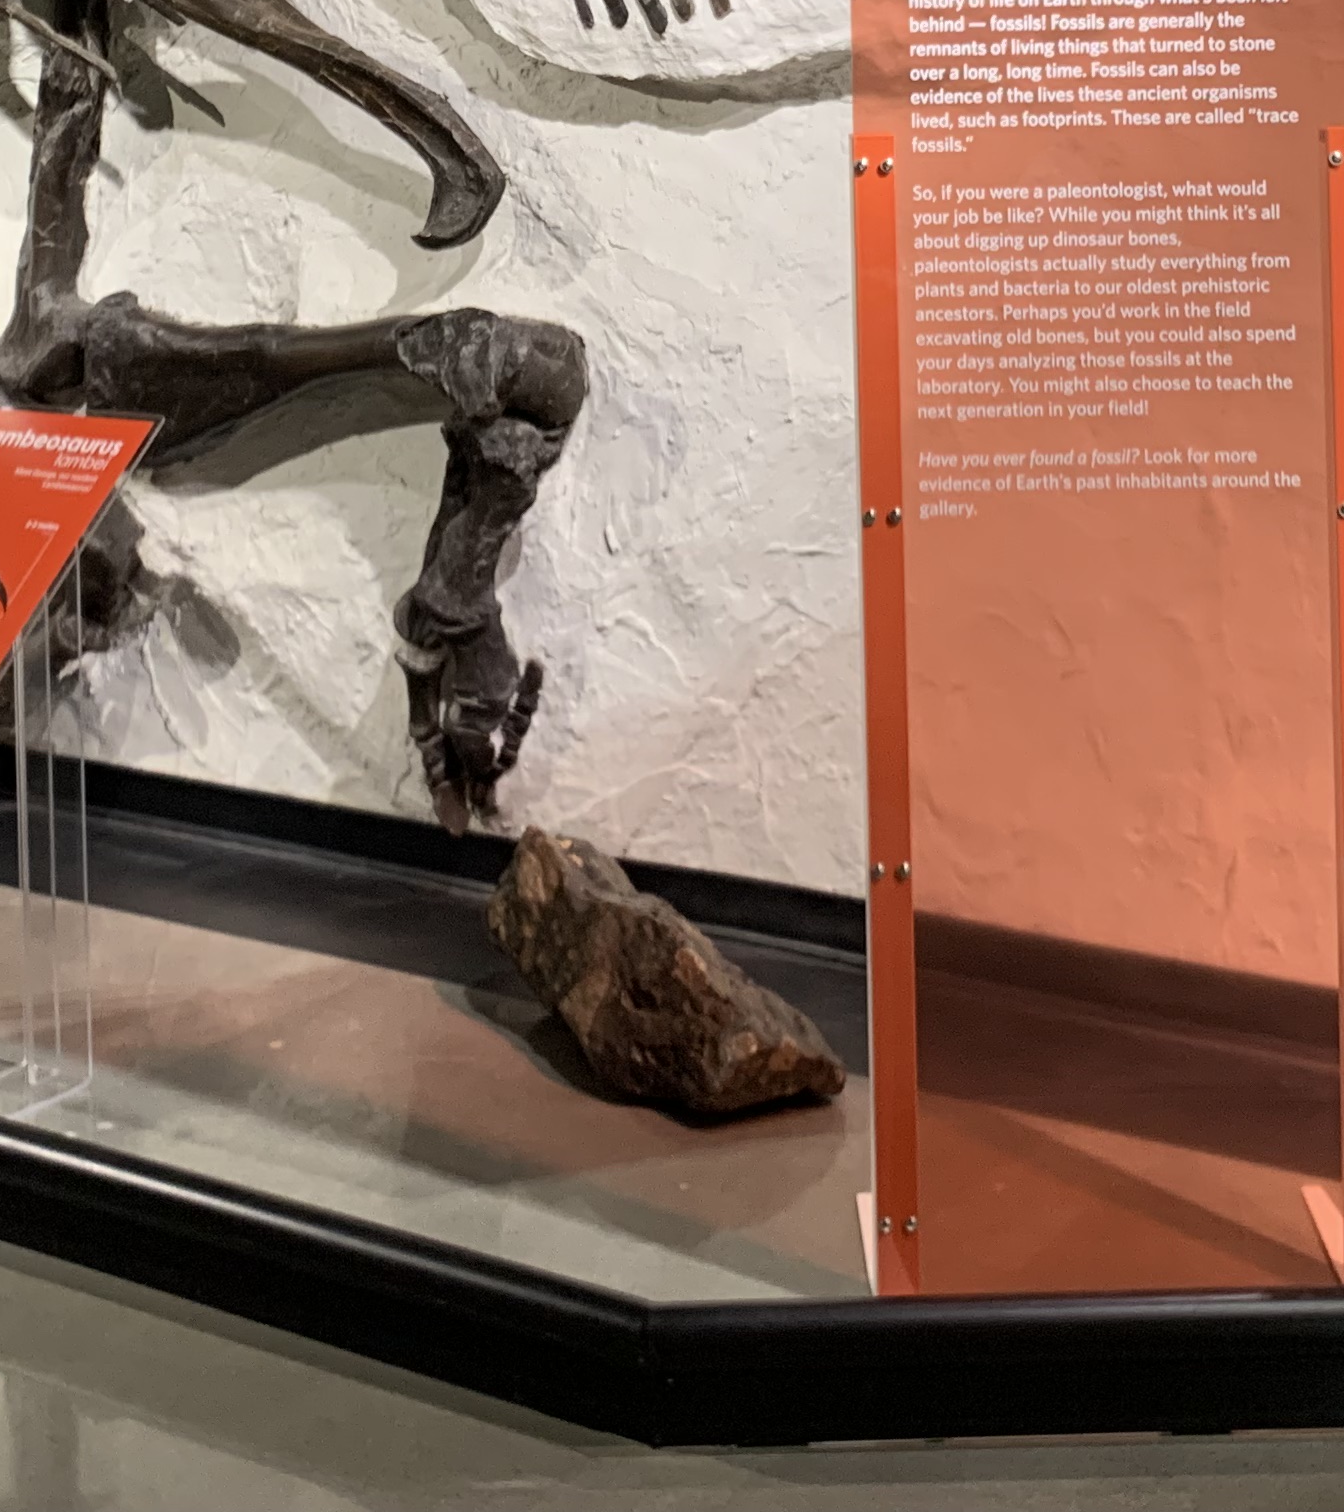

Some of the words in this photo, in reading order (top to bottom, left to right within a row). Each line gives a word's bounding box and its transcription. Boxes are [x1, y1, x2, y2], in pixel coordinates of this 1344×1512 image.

[908, 15, 965, 33] behind
[989, 14, 1046, 31] fossils!
[1050, 13, 1105, 30] Fossils
[1107, 16, 1135, 30] are
[1138, 11, 1214, 32] generally
[1216, 10, 1245, 28] the
[909, 40, 987, 57] remnants
[989, 38, 1007, 55] of
[1010, 38, 1055, 58] living
[1057, 37, 1109, 57] things
[1112, 36, 1146, 53] that
[1149, 35, 1204, 53] turned
[1207, 36, 1226, 52] to
[1229, 36, 1275, 51] stone
[909, 68, 946, 81] over
[949, 67, 959, 80] a
[963, 63, 1002, 83] long,
[1006, 62, 1042, 82] long
[1044, 62, 1087, 78] time.
[1090, 60, 1145, 78] Fossils
[1148, 64, 1178, 77] can
[1182, 59, 1216, 76] also
[1219, 59, 1241, 76] be
[909, 87, 983, 105] evidence
[985, 86, 1003, 103] of
[1006, 86, 1034, 103] the
[1037, 86, 1074, 102] lives
[1077, 85, 1123, 102] these
[1126, 84, 1188, 101] ancient
[1191, 83, 1277, 103] organisms
[911, 111, 953, 130] lived,
[957, 111, 996, 128] such
[999, 114, 1018, 127] as
[1021, 110, 1107, 129] footprints.
[1110, 109, 1161, 125] These
[1164, 112, 1191, 124] are
[1194, 107, 1244, 124] called
[912, 184, 936, 202] So,
[941, 183, 952, 200] if
[955, 187, 985, 203] you
[989, 187, 1029, 199] were
[1033, 186, 1043, 199] a
[1047, 181, 1167, 201] paleontologist,
[1171, 180, 1212, 197] what
[1216, 179, 1266, 196] would
[912, 212, 949, 228] your
[953, 207, 979, 227] job
[983, 207, 1003, 224] be
[1007, 206, 1044, 223] like?
[1048, 206, 1097, 222] While
[1101, 209, 1131, 225] you
[1135, 204, 1182, 224] might
[1186, 204, 1228, 221] think
[1260, 203, 1280, 220] all
[913, 233, 960, 249] about
[964, 231, 1024, 251] digging
[1028, 234, 1048, 250] up
[1052, 230, 1124, 247] dinosaur
[1128, 229, 1181, 246] bones,
[914, 256, 1038, 276] paleontologists
[1042, 254, 1106, 273] actually
[1110, 253, 1156, 273] study
[1160, 252, 1247, 272] everything
[1250, 251, 1290, 268] from
[914, 281, 964, 300] plants
[968, 280, 999, 296] and
[1003, 279, 1069, 296] bacteria
[1074, 280, 1091, 295] to
[1094, 282, 1122, 295] our
[1126, 277, 1177, 294] oldest
[1181, 276, 1270, 296] prehistoric
[915, 306, 998, 321] ancestors.
[1002, 303, 1068, 322] Perhaps
[1119, 301, 1160, 318] work
[1164, 302, 1179, 318] in
[1183, 301, 1210, 318] the
[1214, 300, 1250, 317] field
[915, 329, 1002, 348] excavating
[1006, 328, 1031, 344] old
[1036, 327, 1088, 344] bones,
[1093, 326, 1120, 343] but
[1124, 330, 1154, 346] you
[1159, 325, 1203, 342] could
[1208, 325, 1242, 342] also
[1246, 324, 1296, 344] spend
[916, 358, 952, 373] your
[956, 353, 994, 372] days
[998, 352, 1076, 371] analyzing
[1080, 351, 1125, 368] those
[1129, 350, 1181, 367] fossils
[1185, 351, 1201, 366] at
[1206, 349, 1232, 366] the
[917, 378, 1003, 396] laboratory.
[1008, 376, 1039, 393] You
[1043, 375, 1090, 395] might
[1094, 375, 1128, 391] also
[1132, 374, 1190, 391] choose
[1194, 375, 1212, 390] to
[1215, 373, 1261, 390] teach
[1265, 373, 1293, 390] the
[917, 404, 951, 418] next
[956, 402, 1043, 421] generation
[1048, 401, 1062, 416] in
[1067, 404, 1103, 419] your
[1108, 399, 1148, 415] field!
